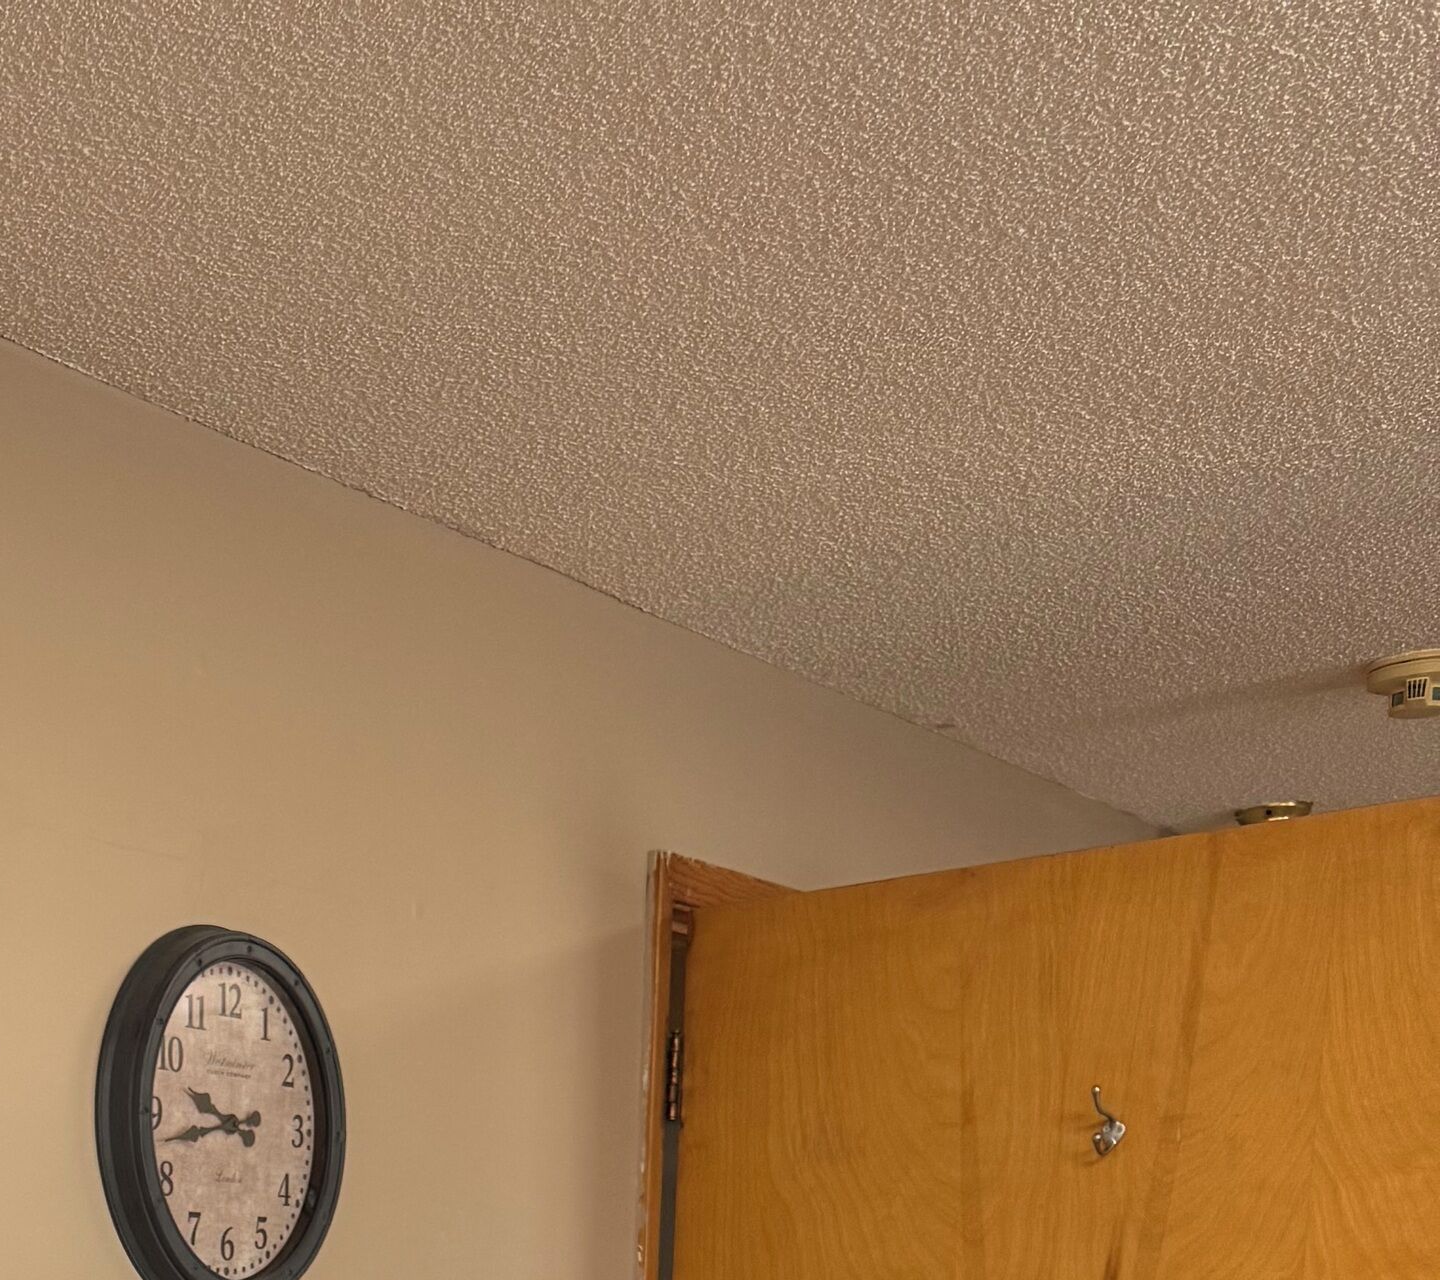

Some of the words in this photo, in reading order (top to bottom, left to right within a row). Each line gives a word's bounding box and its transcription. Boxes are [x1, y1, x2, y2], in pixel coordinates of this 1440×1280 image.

[185, 994, 207, 1031] 11
[217, 982, 243, 1020] 12
[260, 1007, 271, 1041] 1
[158, 1036, 183, 1073] 10
[281, 1054, 295, 1088] 2
[291, 1114, 304, 1149] 3
[160, 1160, 174, 1197] 8
[277, 1173, 291, 1207] 4
[187, 1212, 201, 1246] 7
[220, 1227, 234, 1261] 6
[255, 1216, 268, 1250] 5
